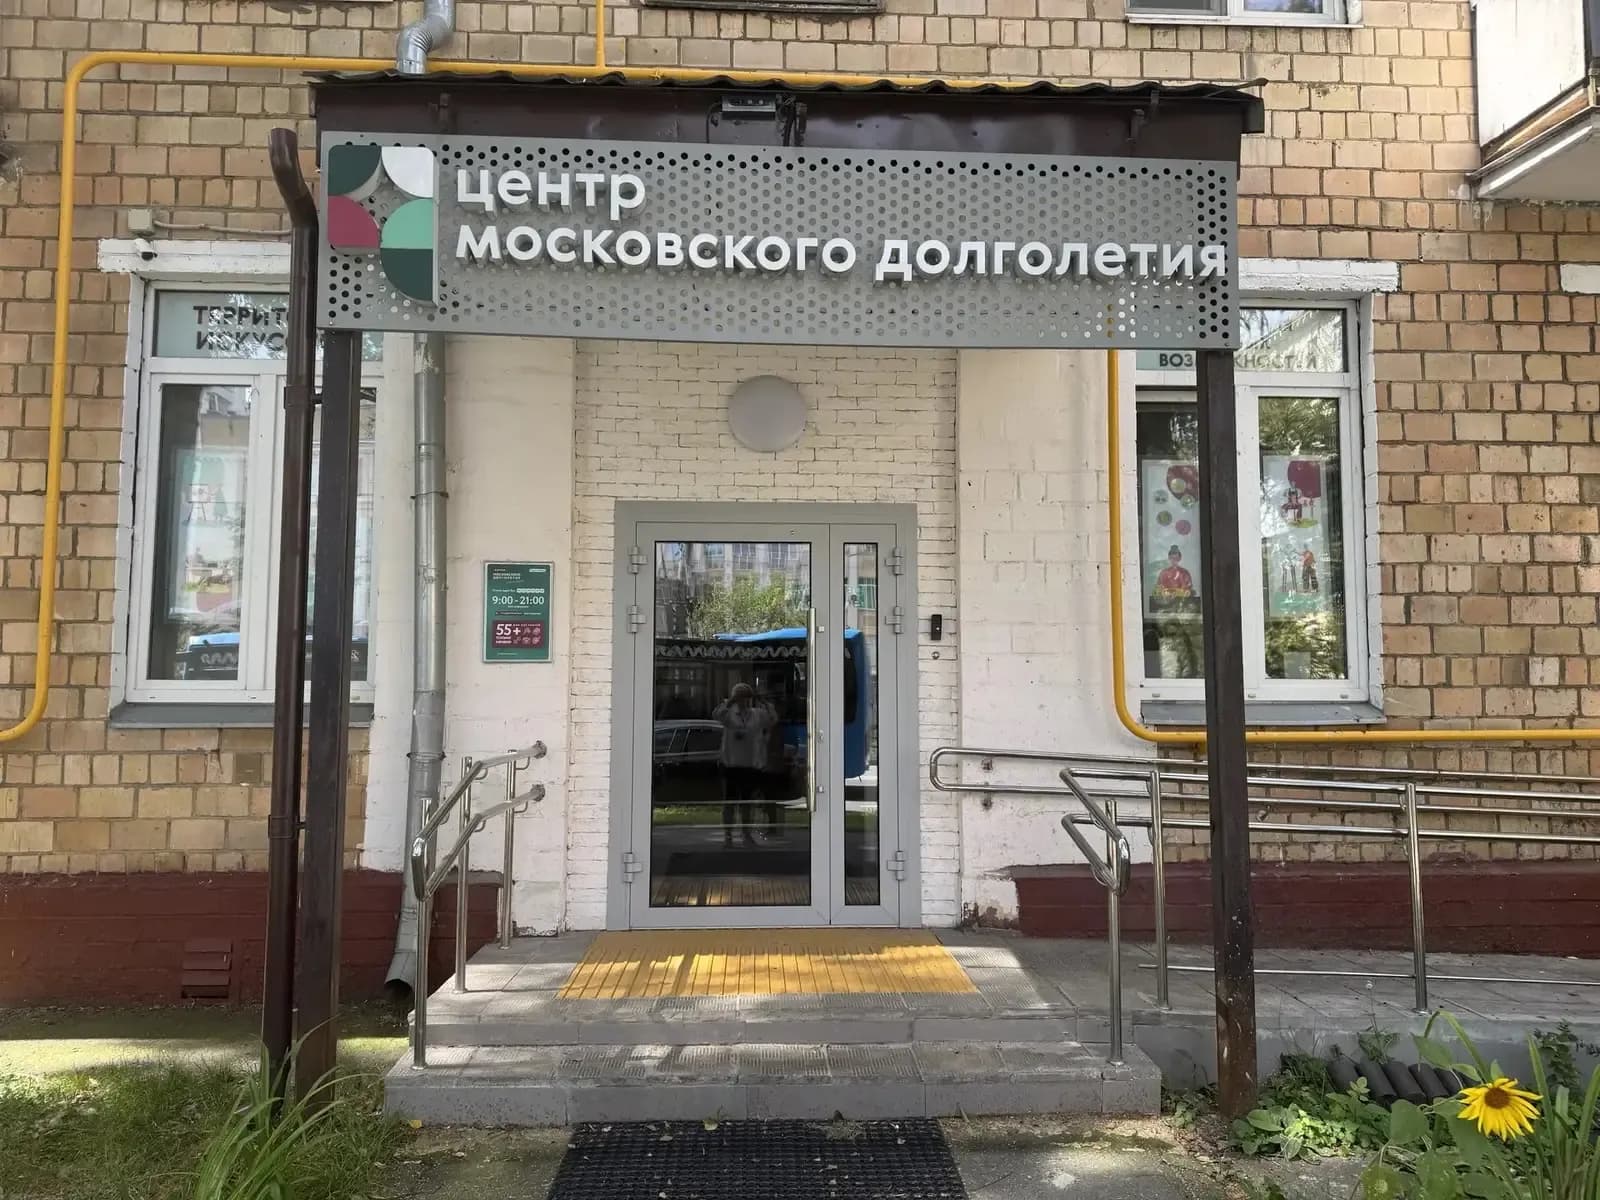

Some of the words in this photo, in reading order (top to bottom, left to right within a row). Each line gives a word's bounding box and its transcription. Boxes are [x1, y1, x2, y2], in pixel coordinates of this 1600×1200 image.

[456, 168, 646, 221] центр
[455, 224, 857, 273] московского
[874, 239, 1226, 282] долголетия
[193, 305, 289, 326] ТЕРРИТ
[196, 331, 289, 351] ИСКУС
[495, 623, 521, 636] 55+
